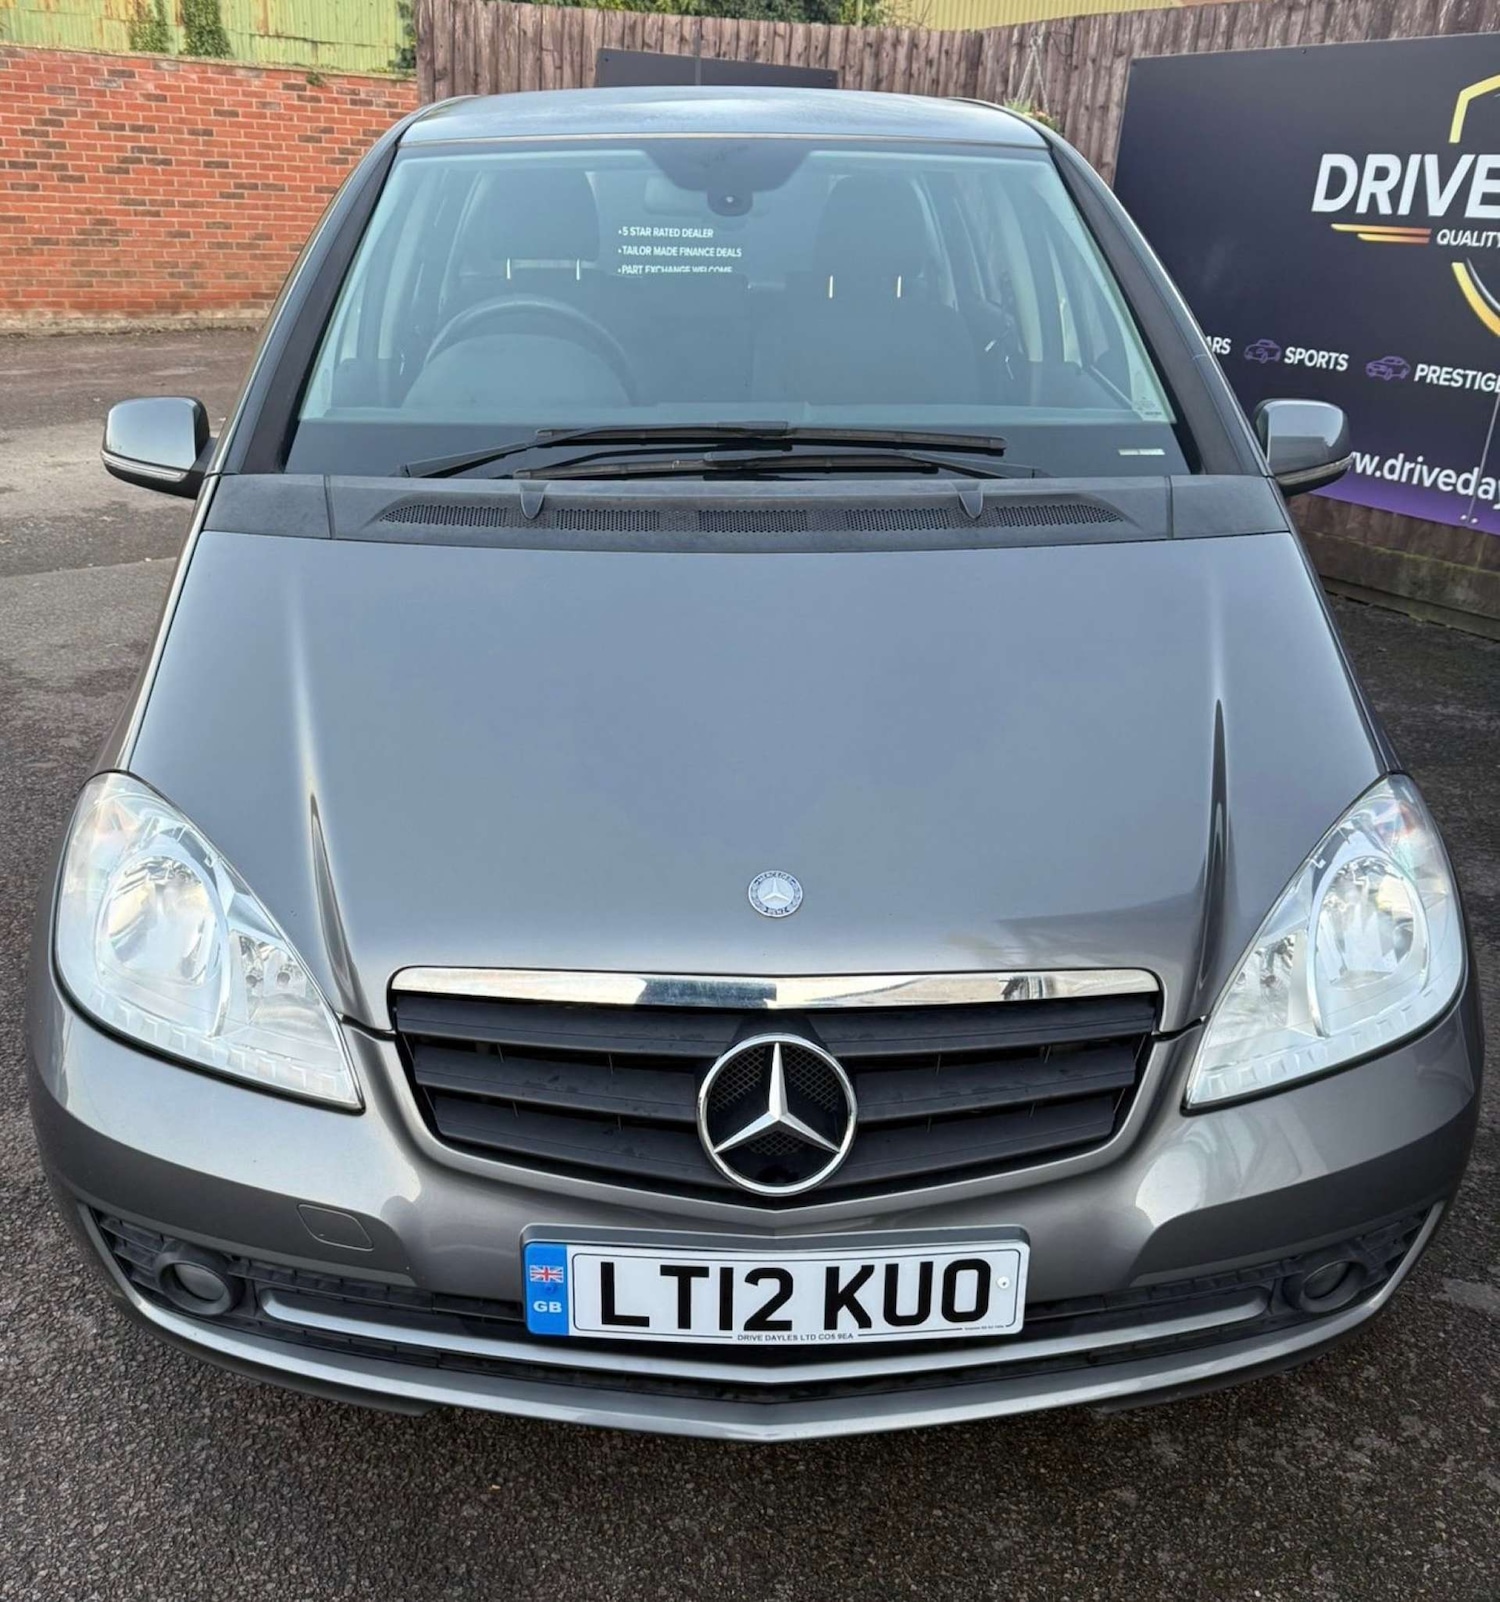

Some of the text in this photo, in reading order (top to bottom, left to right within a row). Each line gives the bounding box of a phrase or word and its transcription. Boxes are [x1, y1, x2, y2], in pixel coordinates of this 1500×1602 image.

[622, 226, 714, 238] 5 STAR RATED DEALER
[1436, 228, 1500, 248] QUALIT
[622, 245, 742, 258] TAILOR MADE FINANCE DEALS
[621, 264, 643, 274] PART
[1284, 346, 1350, 371] SPORTS
[823, 1258, 991, 1330] KUO
[533, 1300, 562, 1313] GB
[765, 1334, 798, 1342] DAYLES
[800, 1333, 817, 1341] LTD
